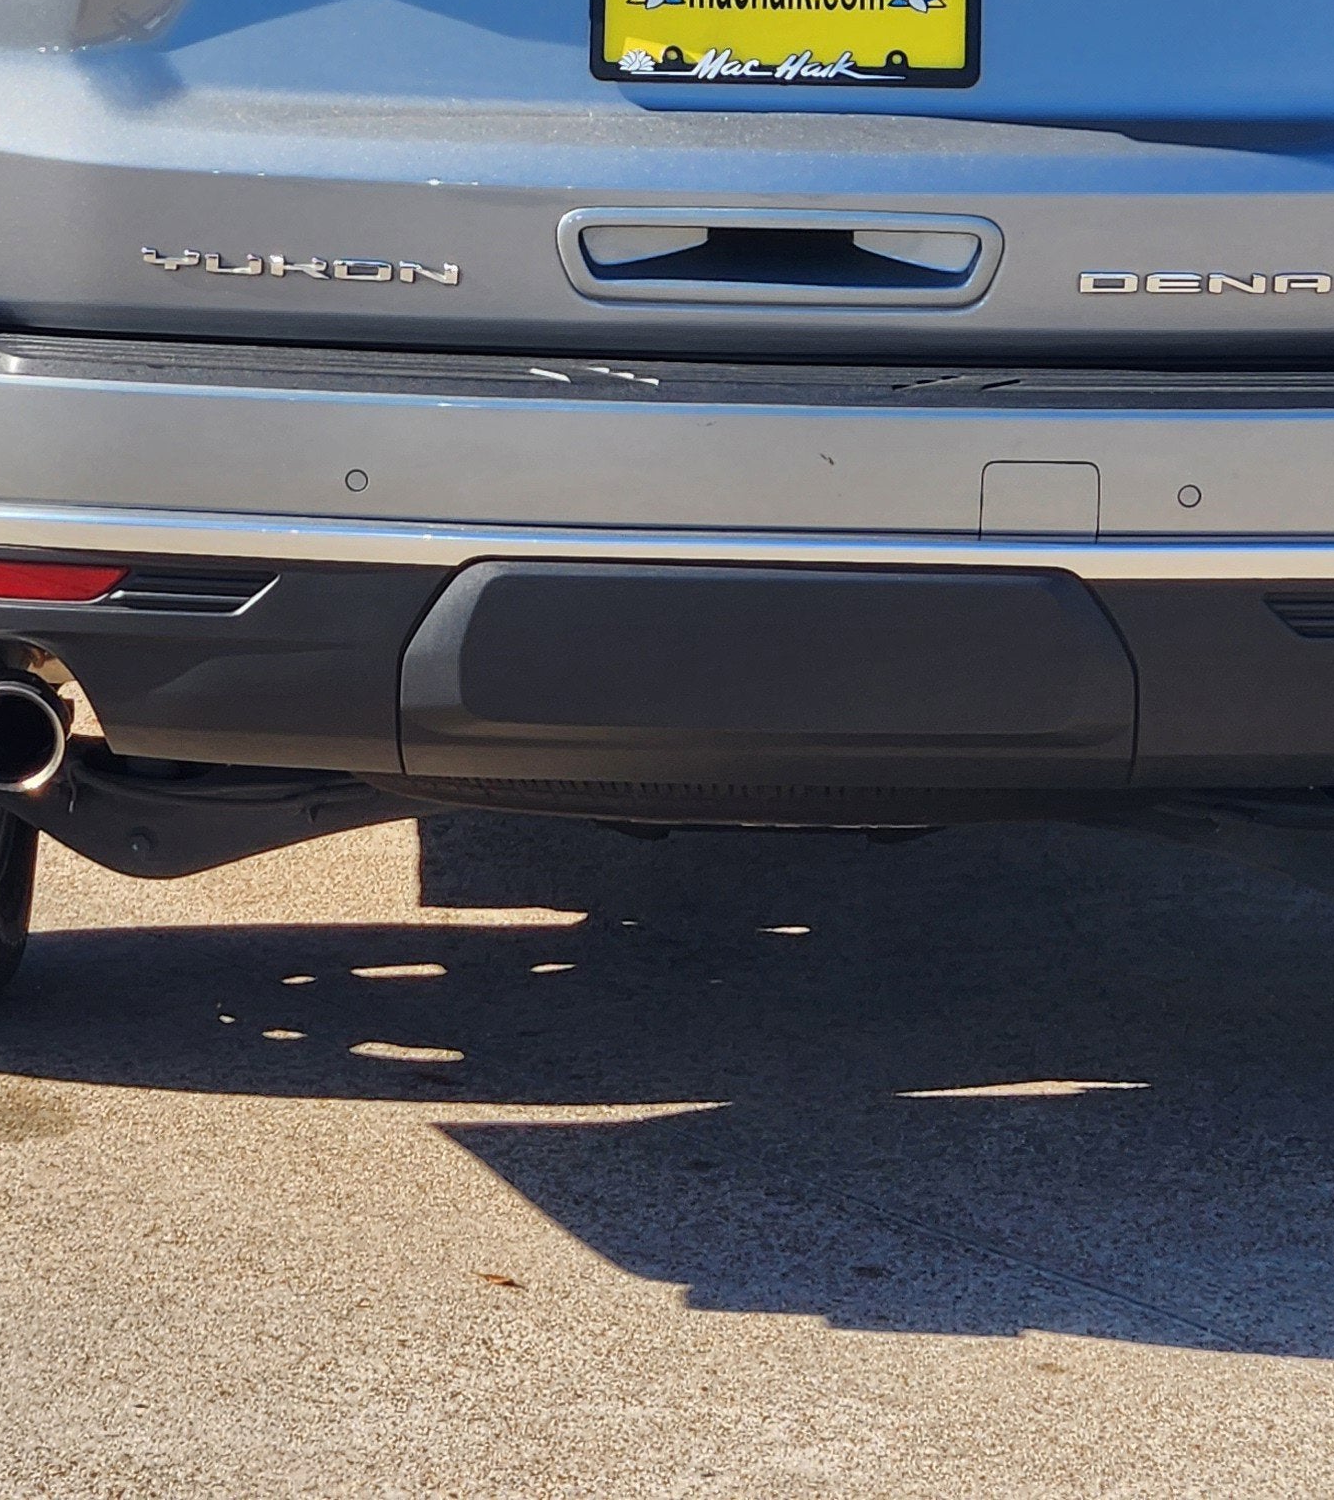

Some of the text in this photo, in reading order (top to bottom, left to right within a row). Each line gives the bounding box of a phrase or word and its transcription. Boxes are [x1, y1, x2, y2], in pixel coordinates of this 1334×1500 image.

[693, 47, 862, 81] Mac Haik
[140, 245, 461, 286] YUKON
